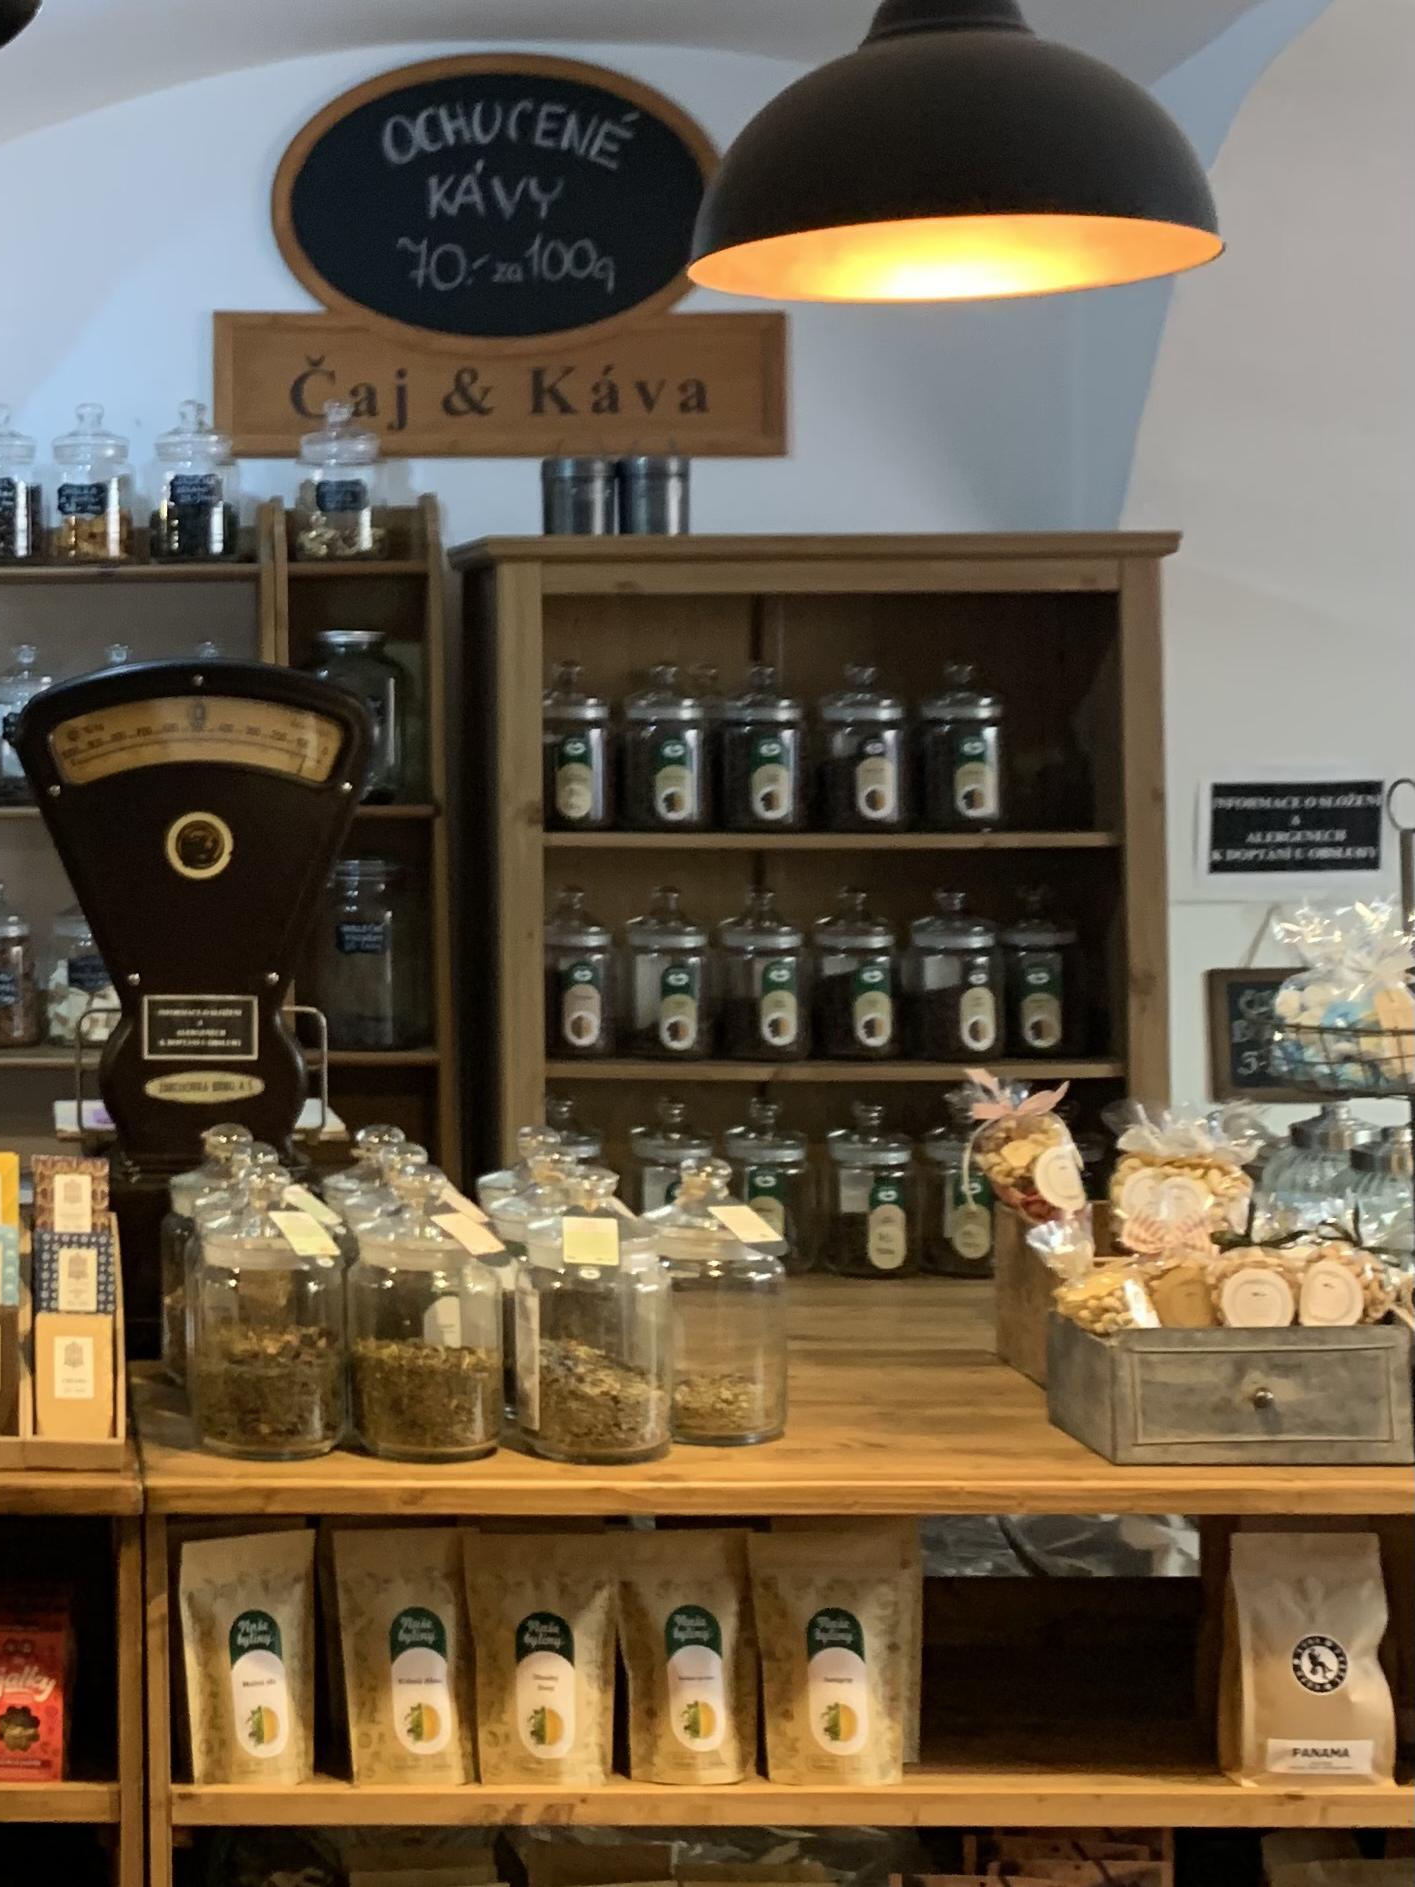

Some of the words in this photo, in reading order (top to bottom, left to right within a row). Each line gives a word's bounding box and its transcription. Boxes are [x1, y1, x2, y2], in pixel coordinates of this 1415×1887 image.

[381, 99, 640, 171] OCHUCENÉ
[426, 158, 565, 219] KÁVY
[524, 232, 616, 294] 100g
[290, 354, 408, 431] Čaj
[441, 366, 495, 417] &
[529, 363, 710, 416] Káva
[1292, 1747, 1350, 1759] PANAMA
